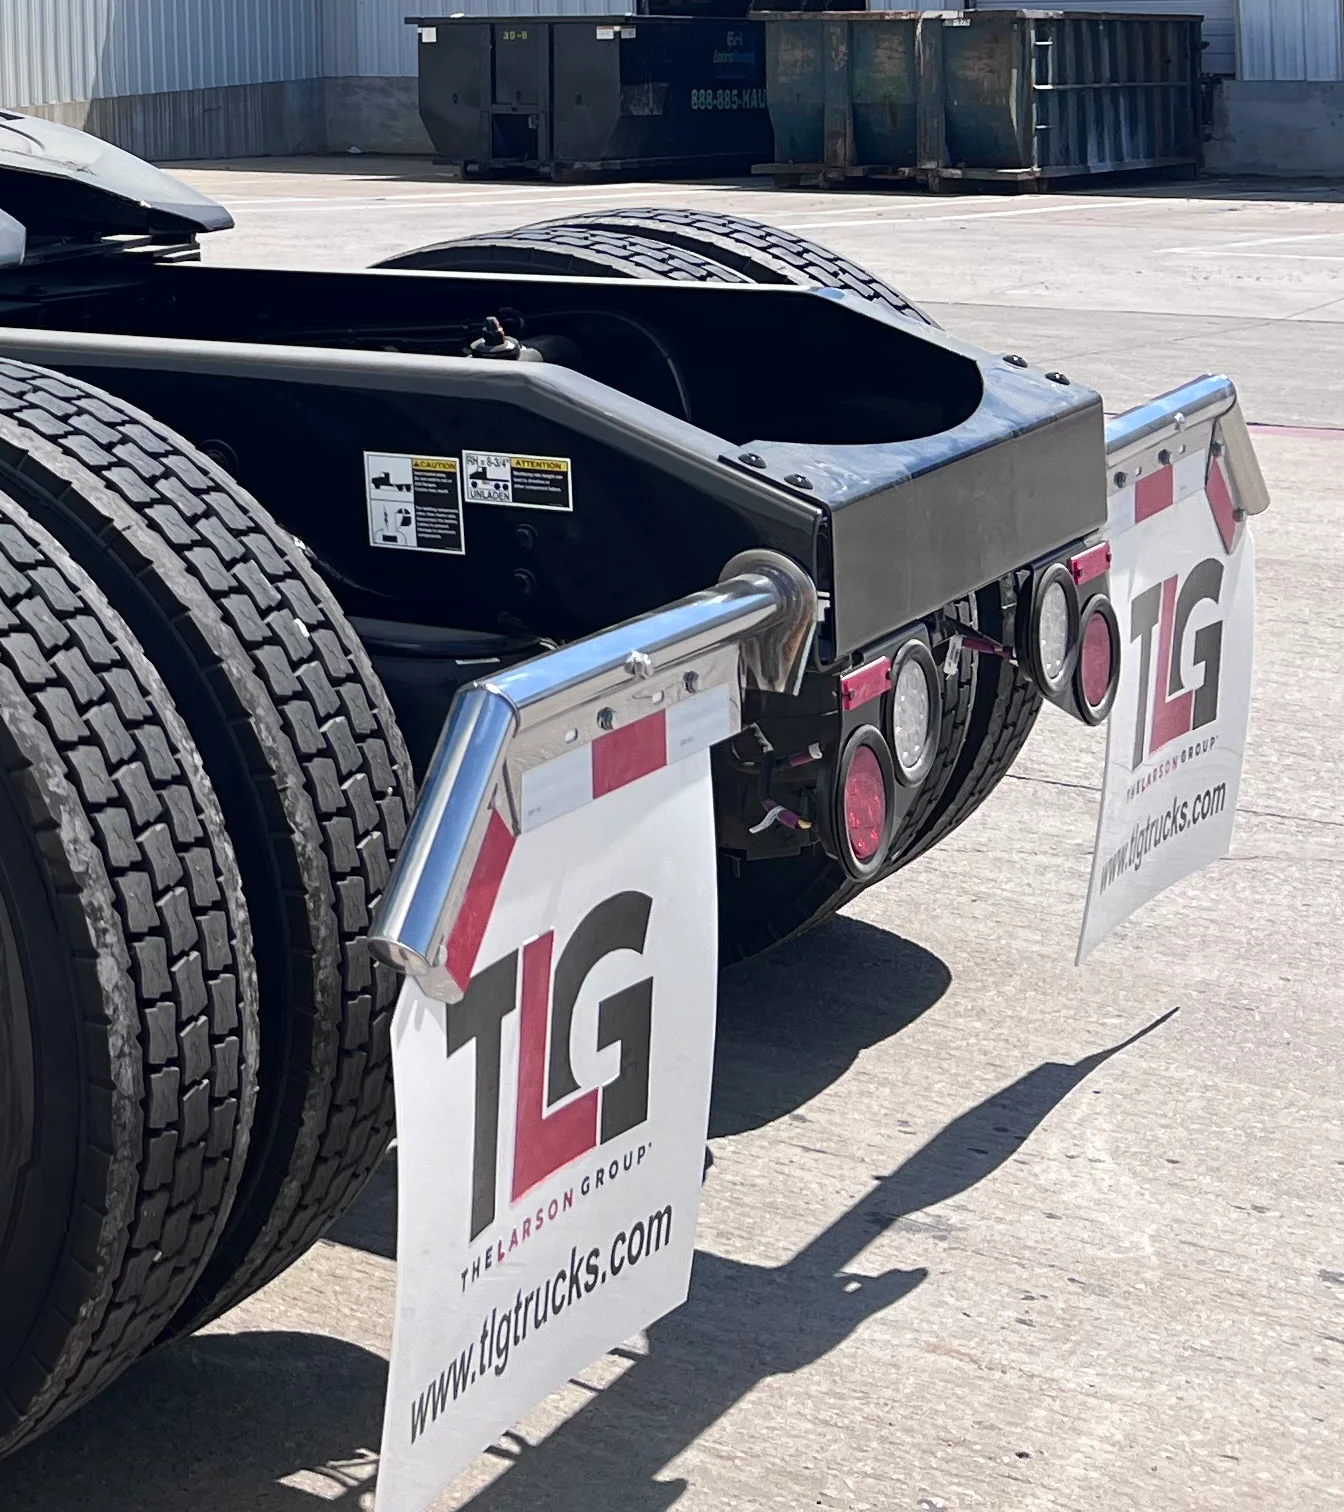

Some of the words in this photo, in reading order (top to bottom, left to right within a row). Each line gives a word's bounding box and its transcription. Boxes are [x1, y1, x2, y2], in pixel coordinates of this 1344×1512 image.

[420, 460, 457, 470] CAUTION
[515, 459, 562, 470] ATTENTION
[470, 489, 510, 501] UNLADEN
[1130, 557, 1224, 773] TLG
[1180, 736, 1216, 764] GROUP
[1099, 782, 1227, 895] www.tlgtrucks.com
[446, 890, 653, 1242] TLG
[581, 1145, 646, 1196] GROUP
[410, 1204, 674, 1446] www.tlgtrucks.com
